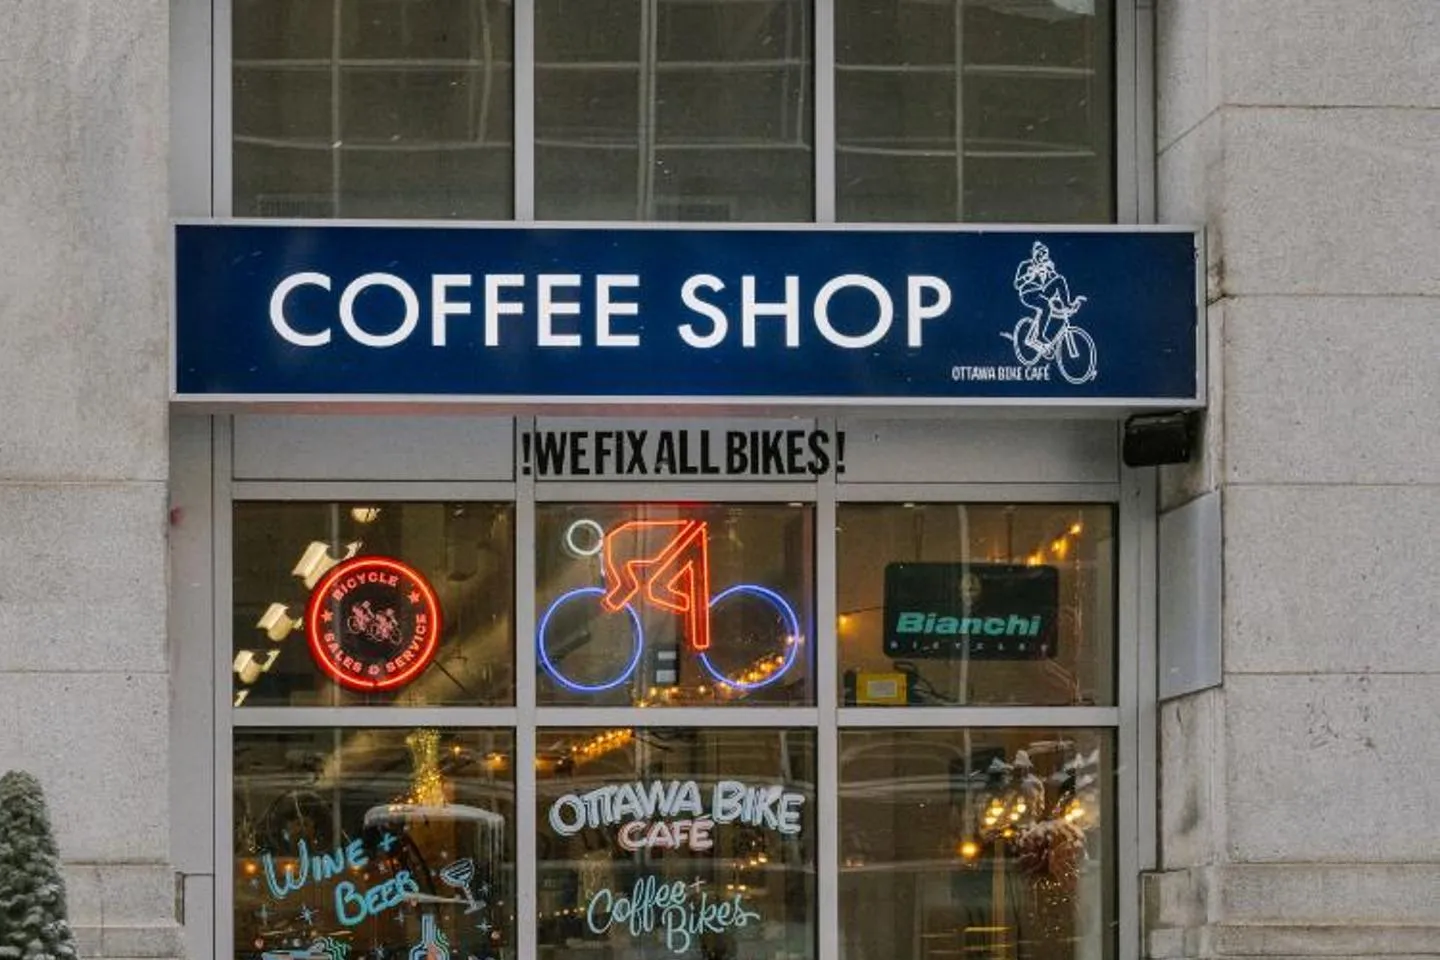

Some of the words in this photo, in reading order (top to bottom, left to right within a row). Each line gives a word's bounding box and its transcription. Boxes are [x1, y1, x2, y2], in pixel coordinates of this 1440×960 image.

[268, 271, 641, 348] COFFEE
[678, 273, 953, 349] SHOP
[951, 366, 995, 381] OTTAWA
[997, 366, 1022, 381] BIKE
[594, 430, 648, 475] FIX
[654, 429, 720, 475] ALL
[331, 571, 400, 601] BICYCLE
[323, 632, 362, 674] SALES
[385, 613, 428, 674] SERVICE
[895, 611, 1042, 636] Bianchi
[547, 780, 704, 837] OTTAWA
[710, 780, 807, 835] BIKE
[616, 813, 716, 851] CAFÉ
[586, 875, 687, 937] Coffee
[661, 892, 761, 954] Bikes
